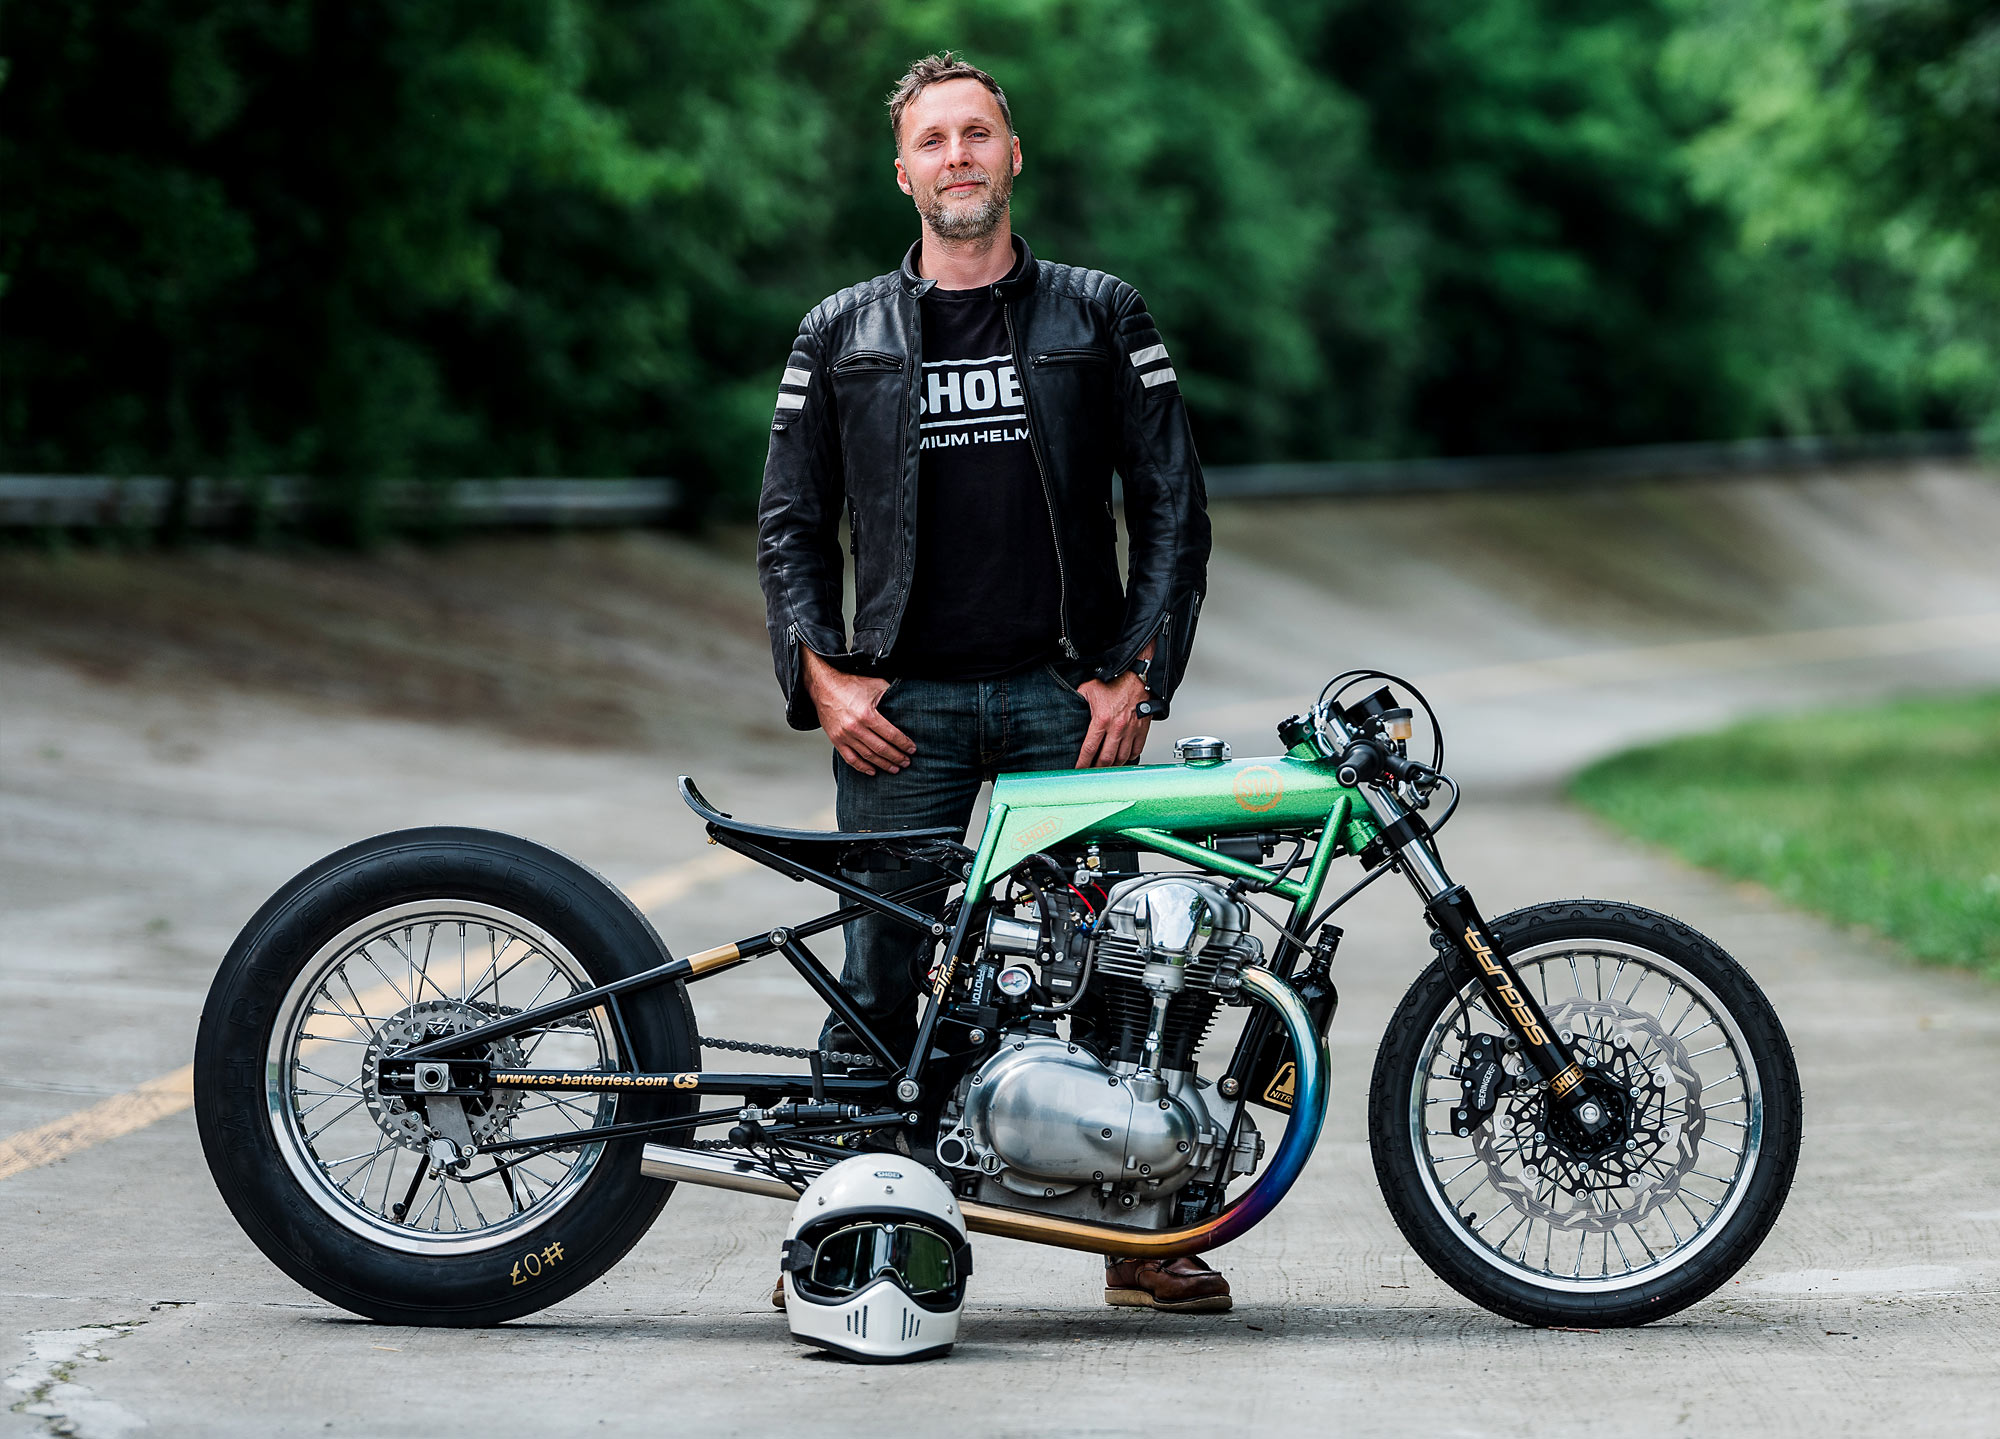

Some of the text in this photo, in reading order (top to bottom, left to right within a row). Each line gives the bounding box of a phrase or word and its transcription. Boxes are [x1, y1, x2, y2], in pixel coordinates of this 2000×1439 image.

[920, 366, 1025, 415] HOE
[1016, 819, 1057, 848] SHOEI
[1464, 926, 1551, 1046] SEGURA
[496, 1073, 699, 1089] www.cs-batteries.com CS
[1478, 1062, 1497, 1110] BERINGER
[509, 1241, 564, 1286] #07
